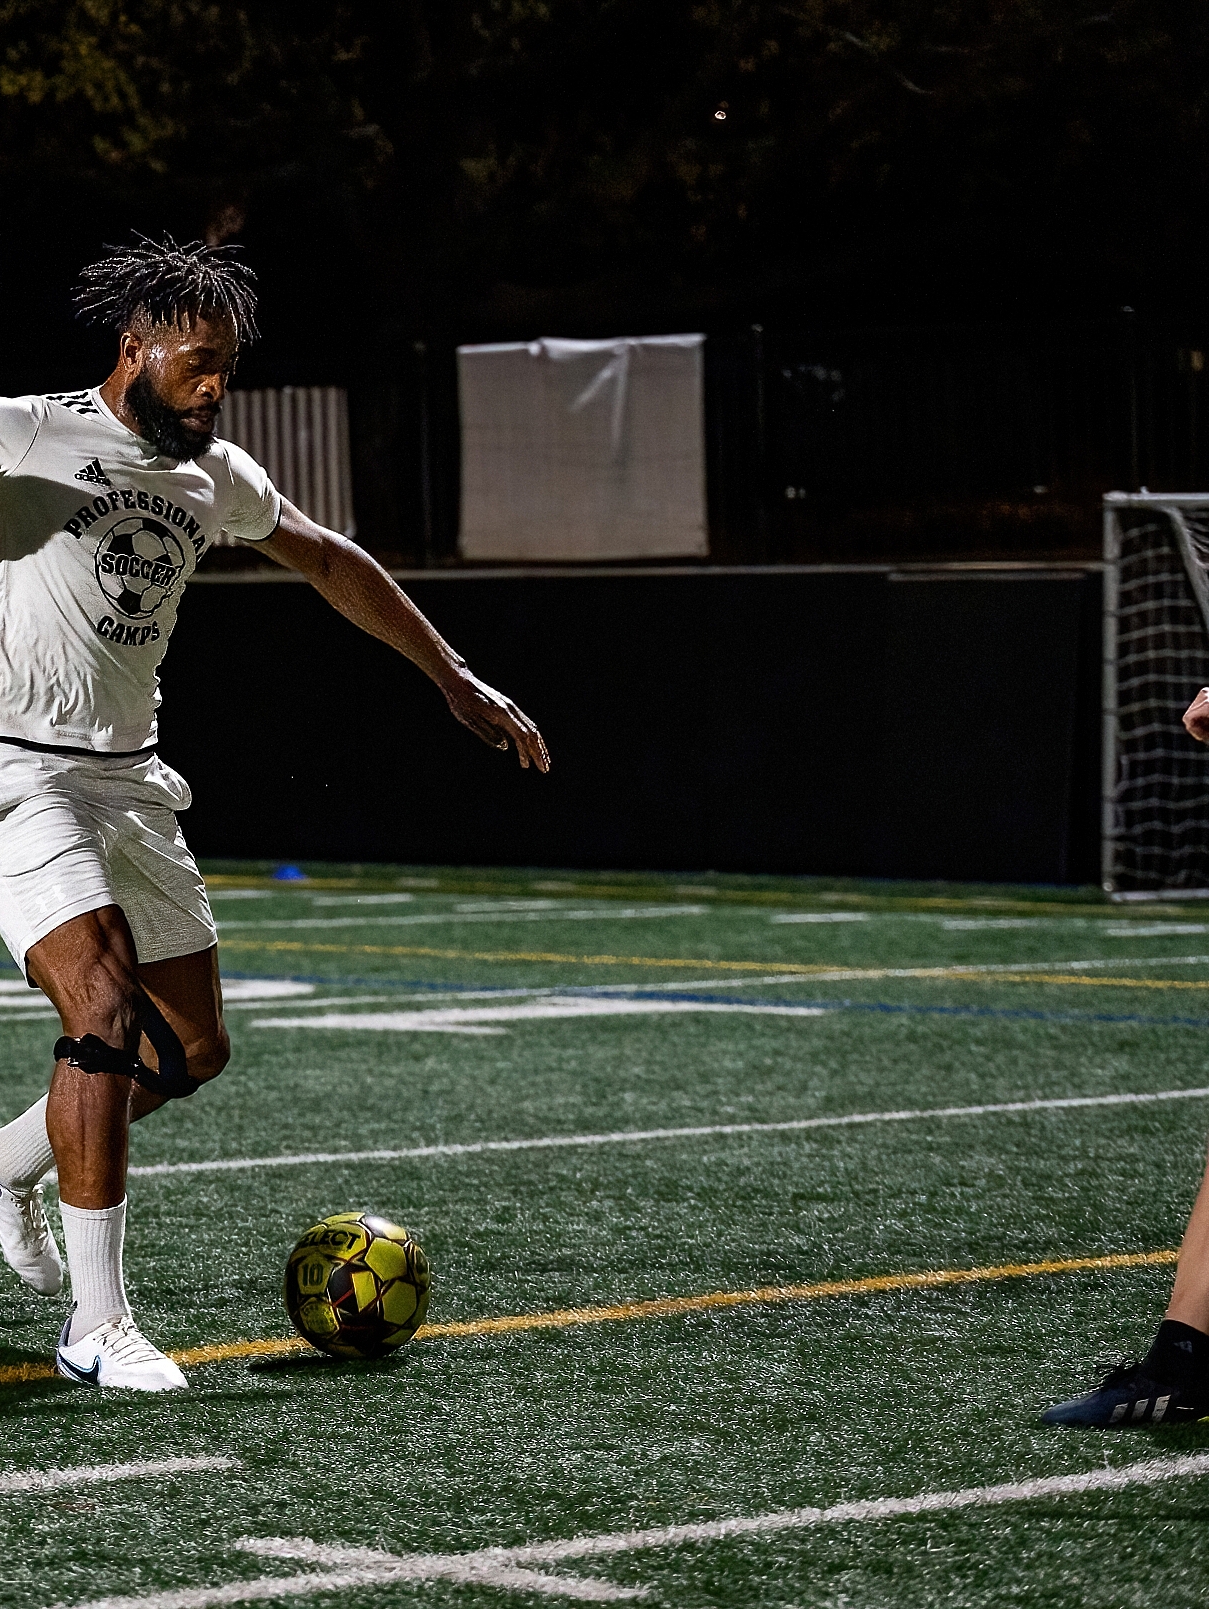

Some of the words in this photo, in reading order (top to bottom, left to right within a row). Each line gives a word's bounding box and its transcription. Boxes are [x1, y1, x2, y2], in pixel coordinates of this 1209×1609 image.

[101, 553, 177, 586] SOCCER
[97, 615, 160, 646] CAMPS
[302, 1263, 324, 1286] 10
